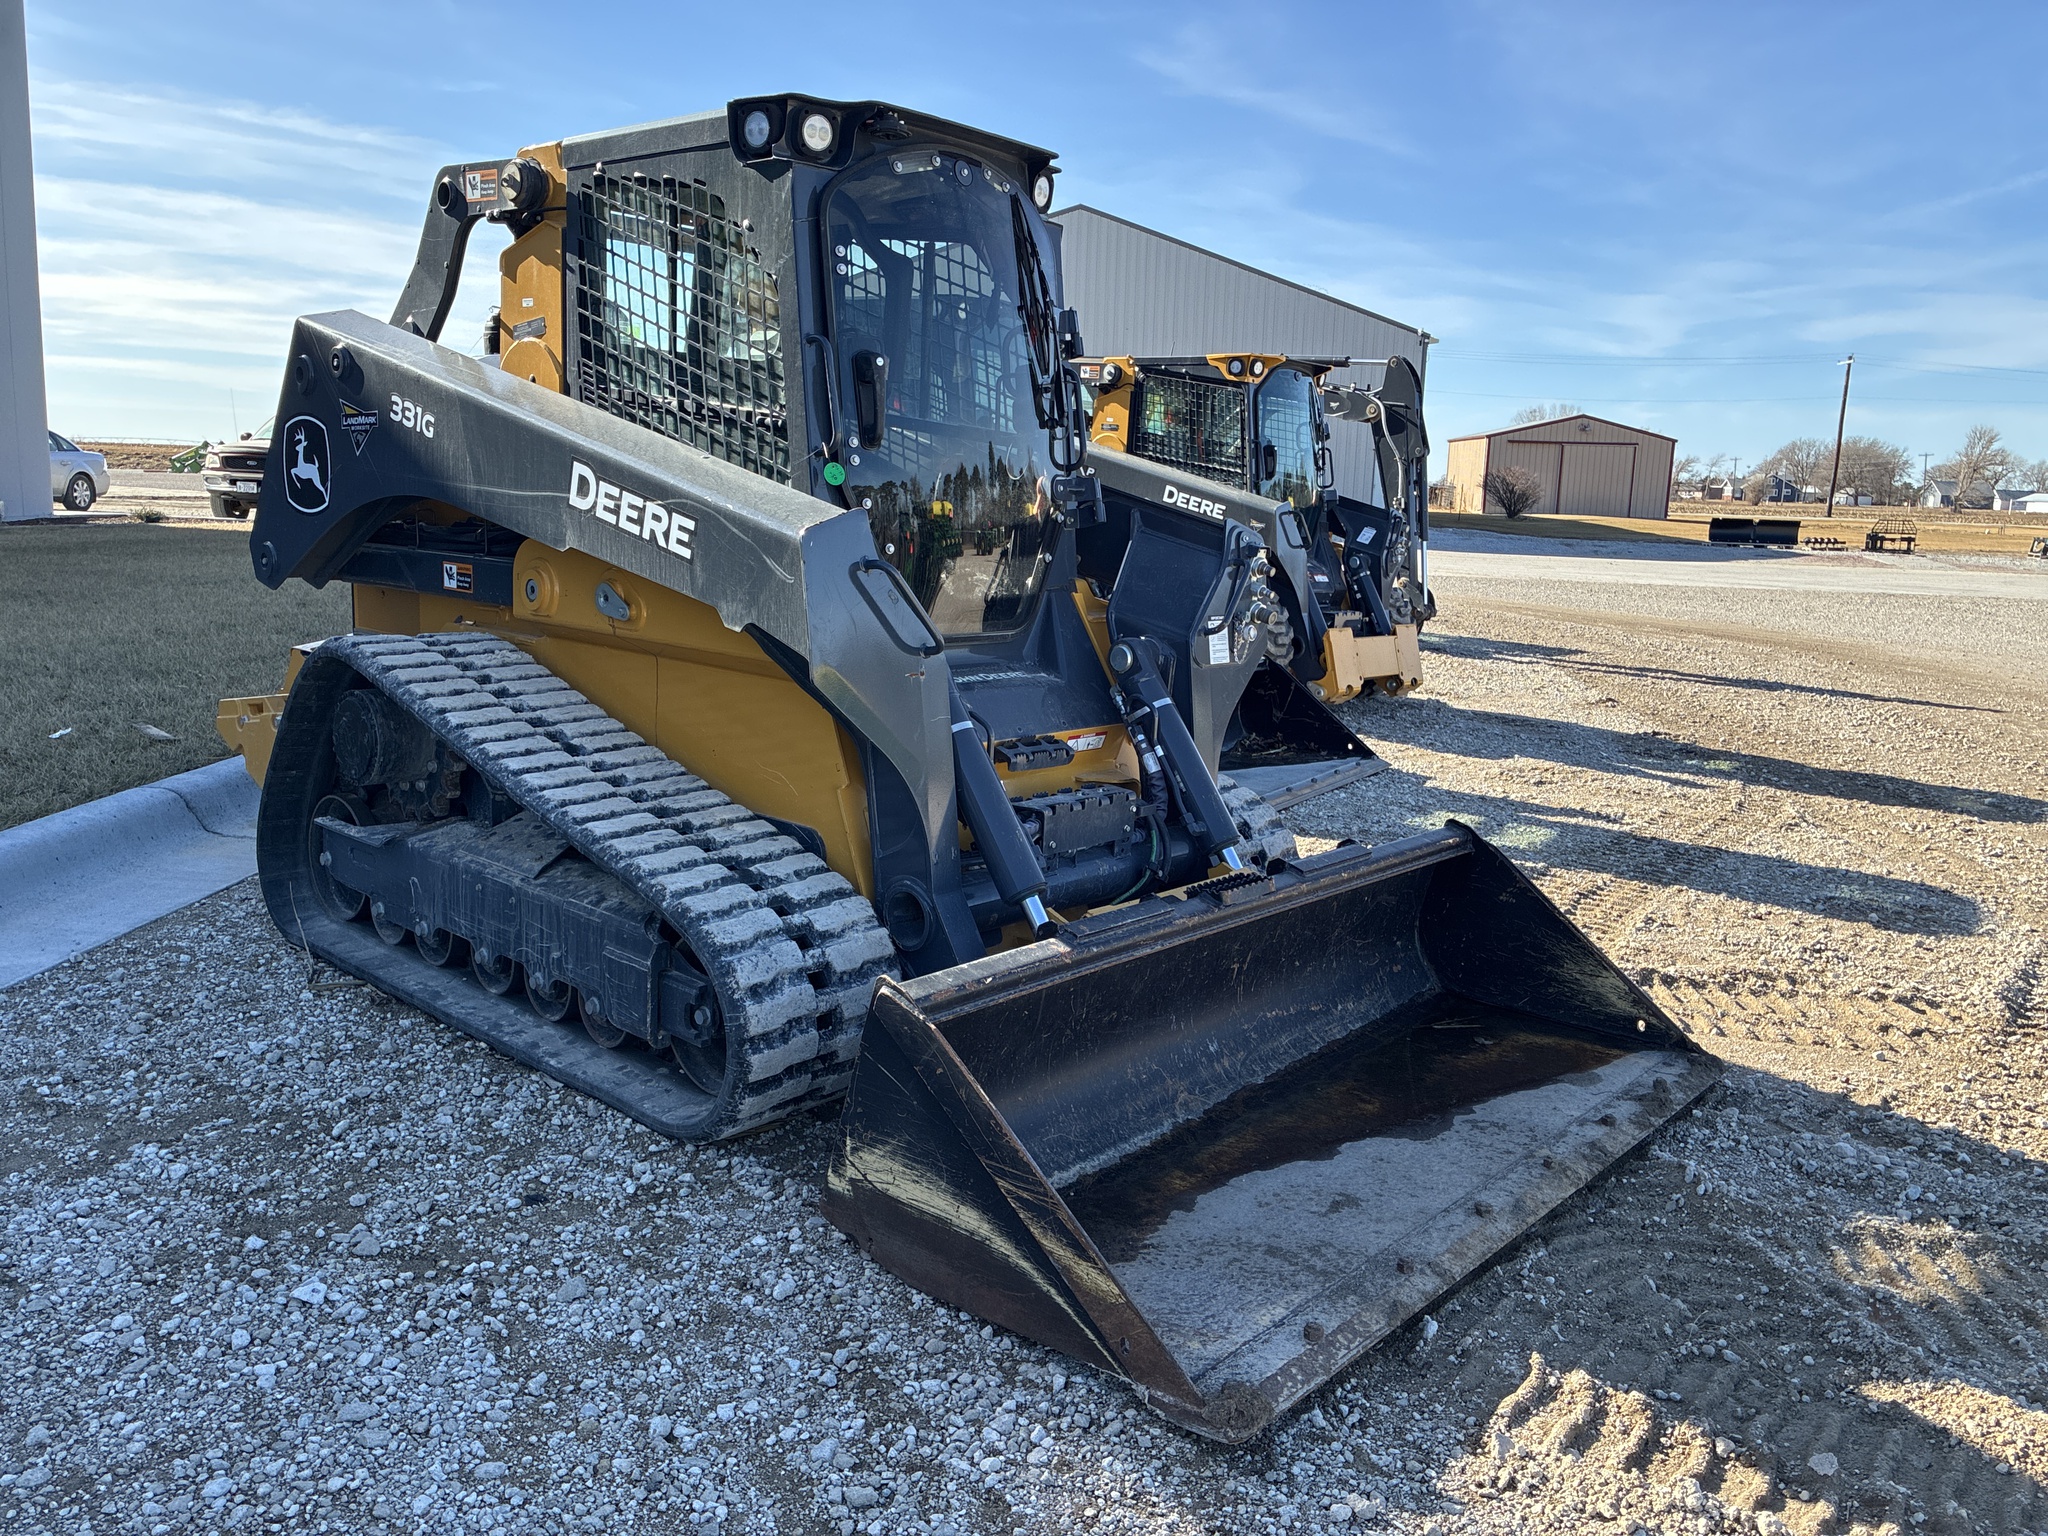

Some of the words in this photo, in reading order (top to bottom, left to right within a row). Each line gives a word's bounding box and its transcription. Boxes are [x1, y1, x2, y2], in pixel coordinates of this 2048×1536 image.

[343, 416, 376, 424] LANDMARK
[390, 394, 435, 438] 331G
[569, 461, 696, 559] DEERE
[1162, 485, 1226, 520] DEERE
[954, 675, 982, 683] OHN
